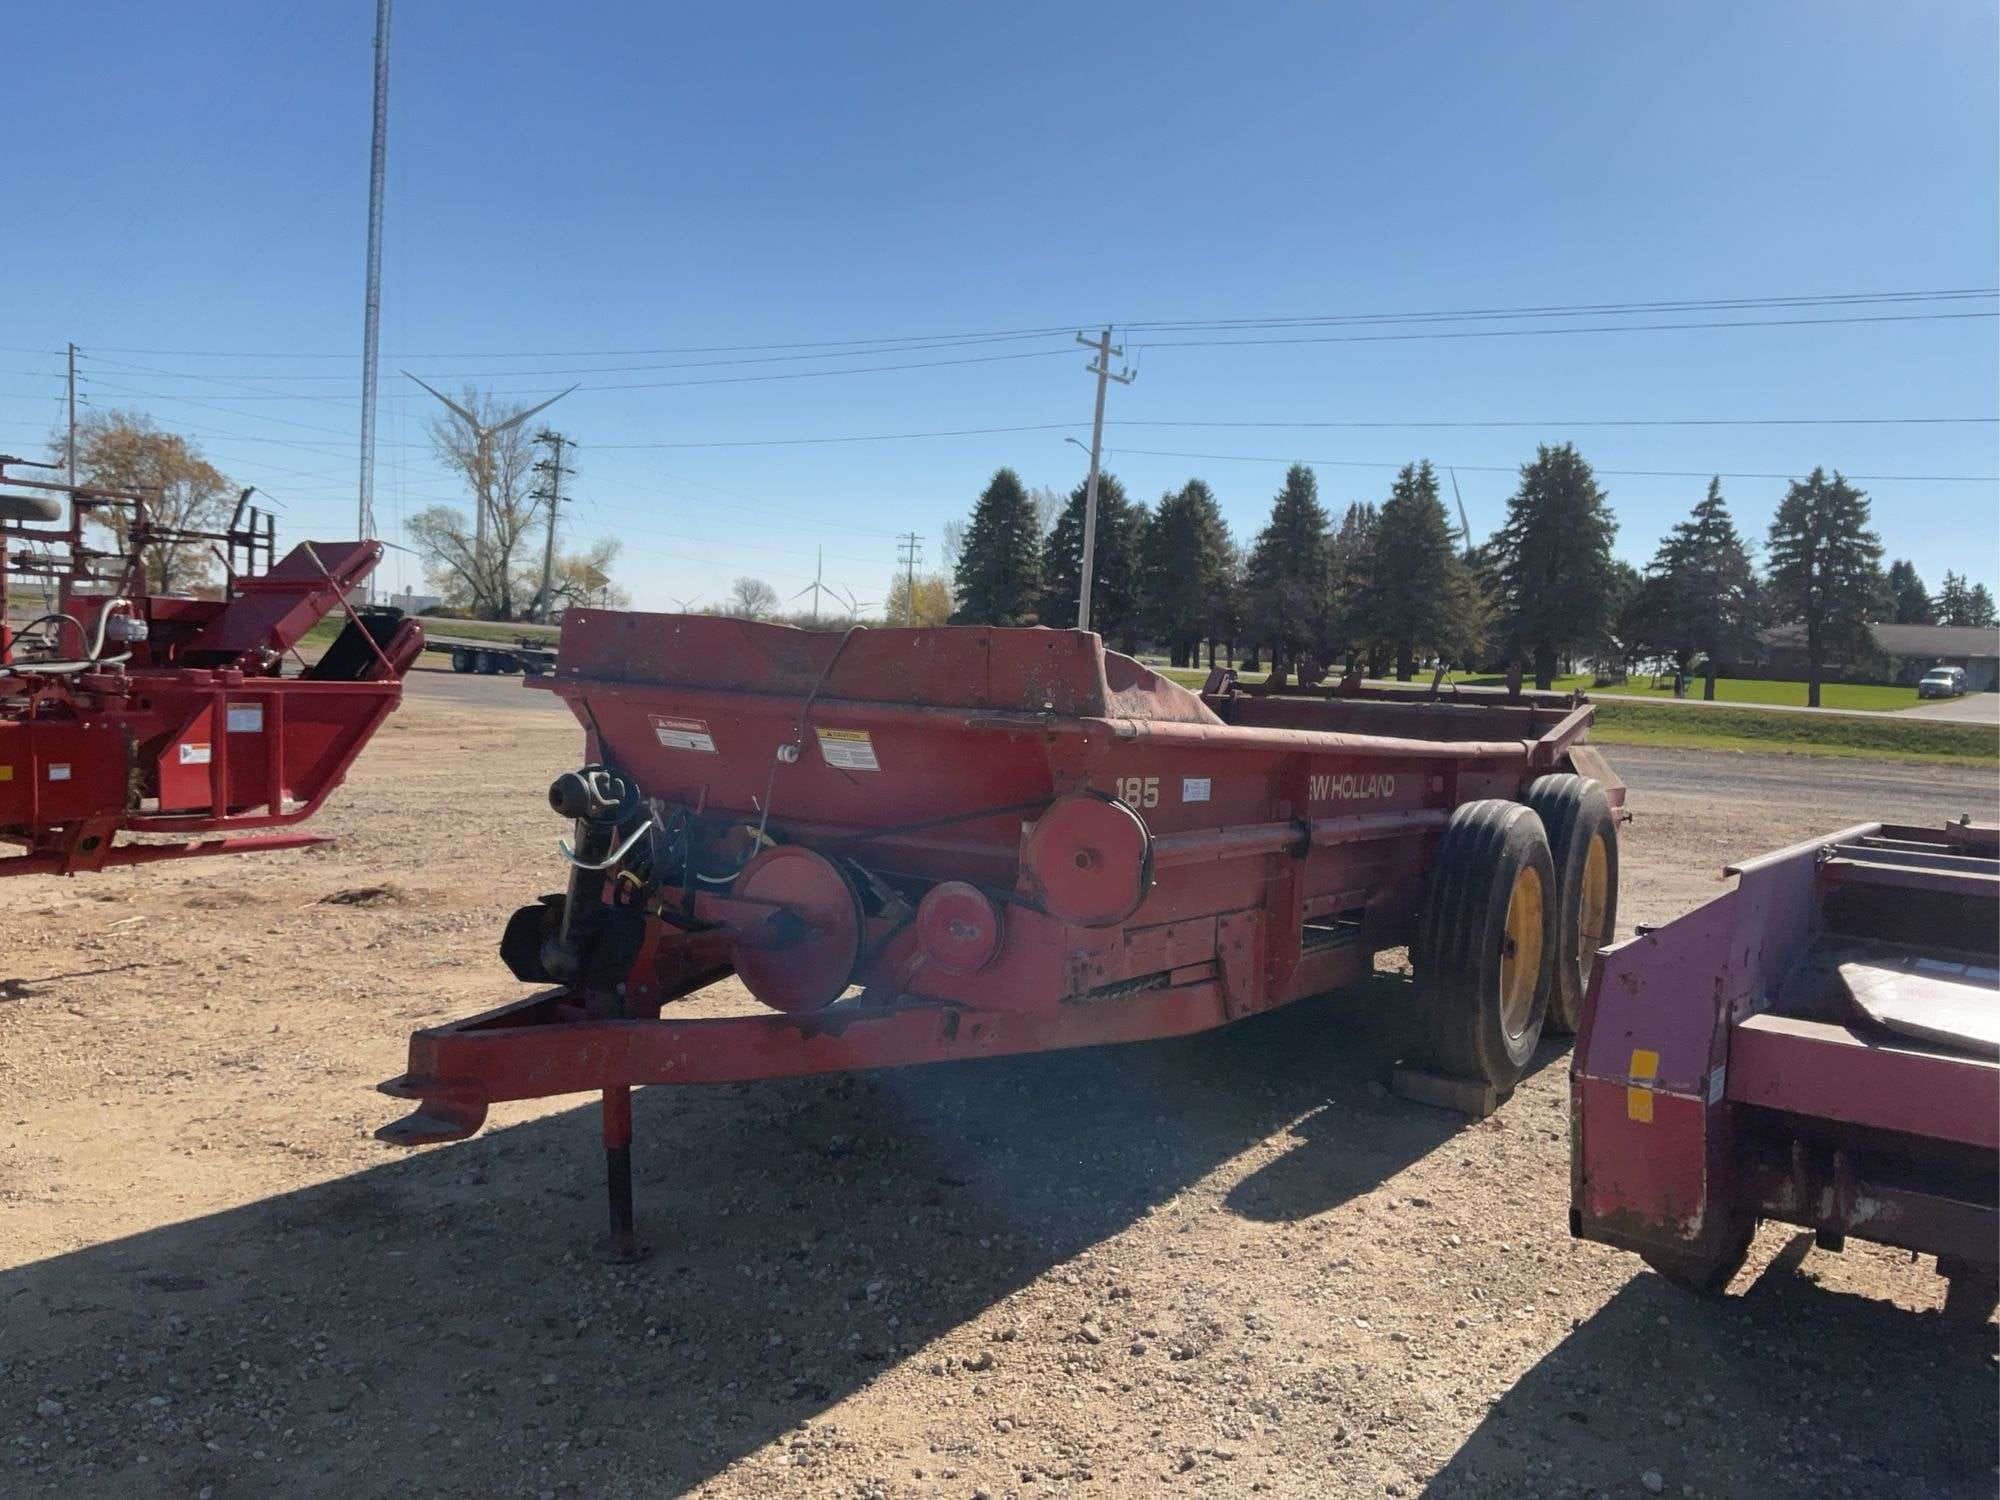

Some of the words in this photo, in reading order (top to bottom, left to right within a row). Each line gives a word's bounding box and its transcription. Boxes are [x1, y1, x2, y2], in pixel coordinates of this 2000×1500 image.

[1116, 777, 1160, 808] 185
[1308, 775, 1329, 800] W
[1331, 775, 1395, 799] HOLLAND
